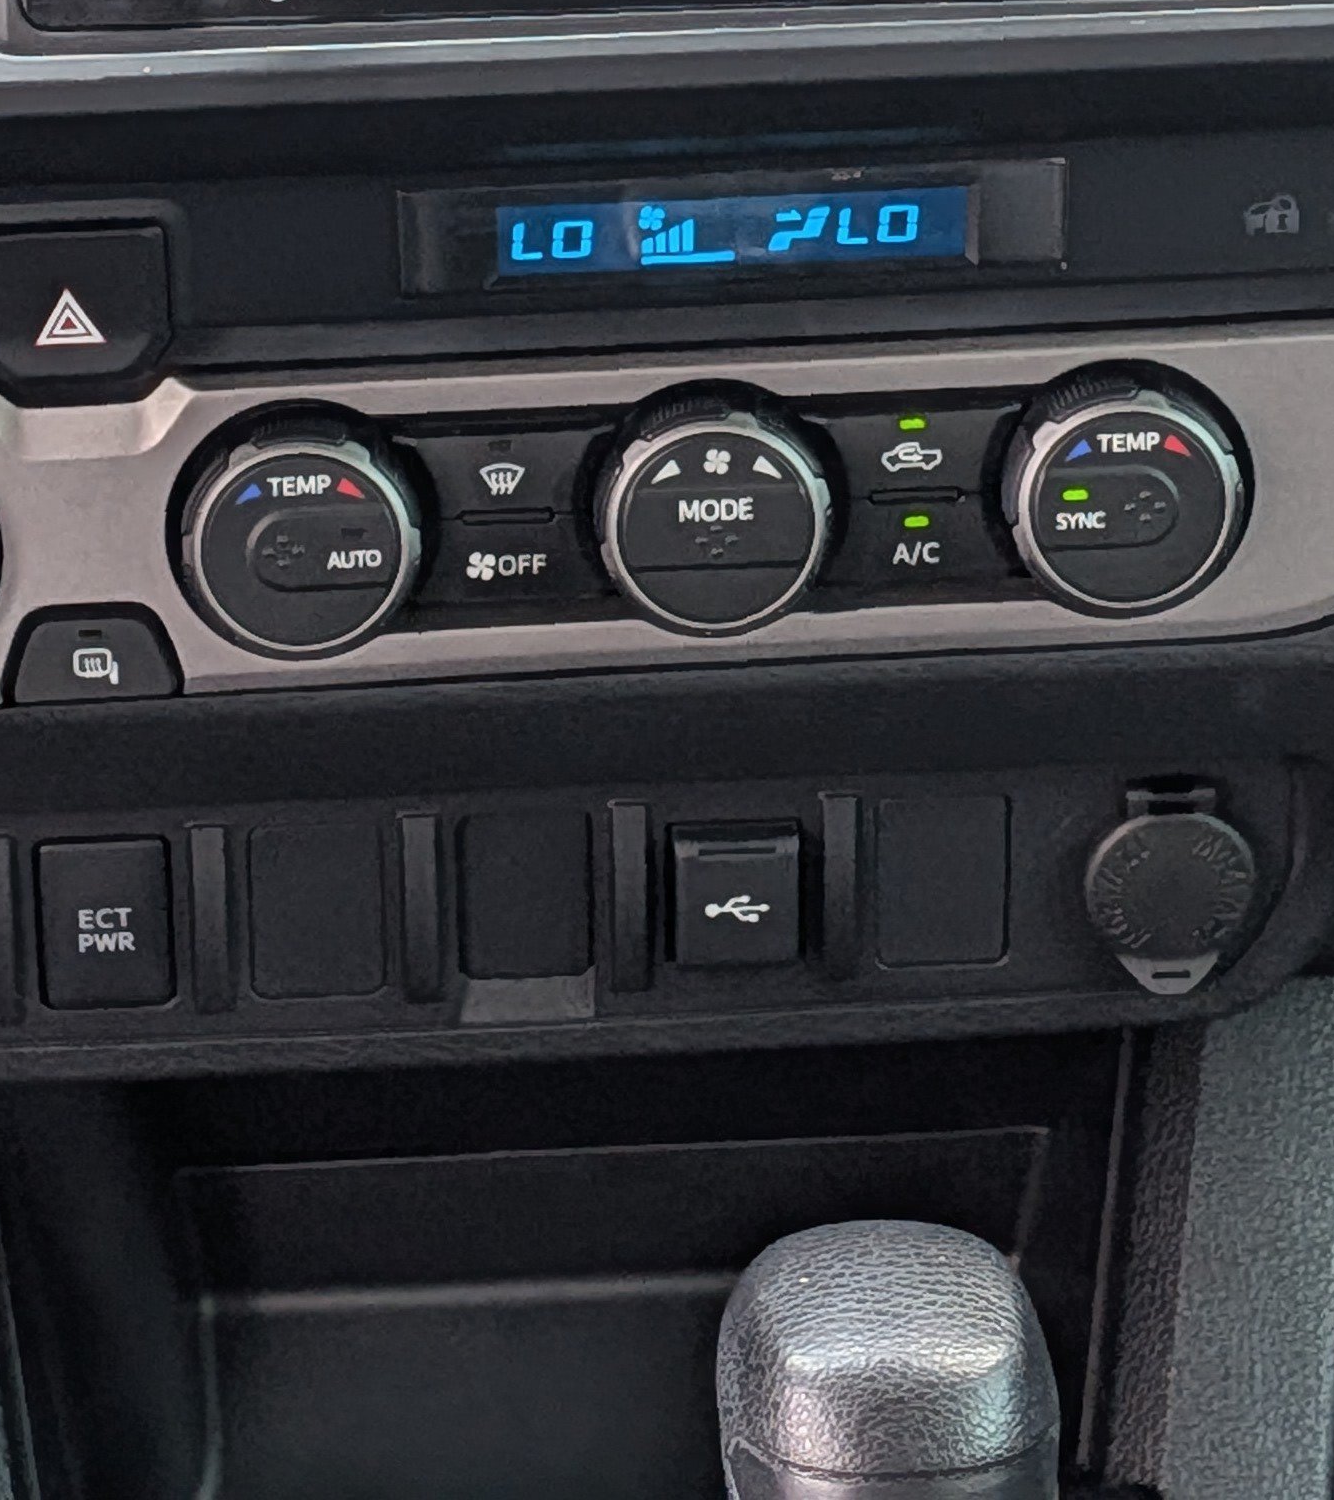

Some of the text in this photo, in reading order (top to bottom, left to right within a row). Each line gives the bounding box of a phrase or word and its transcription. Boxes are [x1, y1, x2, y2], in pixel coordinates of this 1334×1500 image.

[511, 219, 594, 261] LO
[1096, 431, 1161, 453] TEMP
[266, 474, 332, 498] TEMP
[678, 496, 754, 523] MODE
[1055, 510, 1107, 531] SYNC
[326, 549, 383, 570] AUTO
[497, 553, 547, 577] OFF
[892, 541, 941, 566] A/C
[77, 907, 133, 930] ECT
[78, 931, 136, 954] PWR
